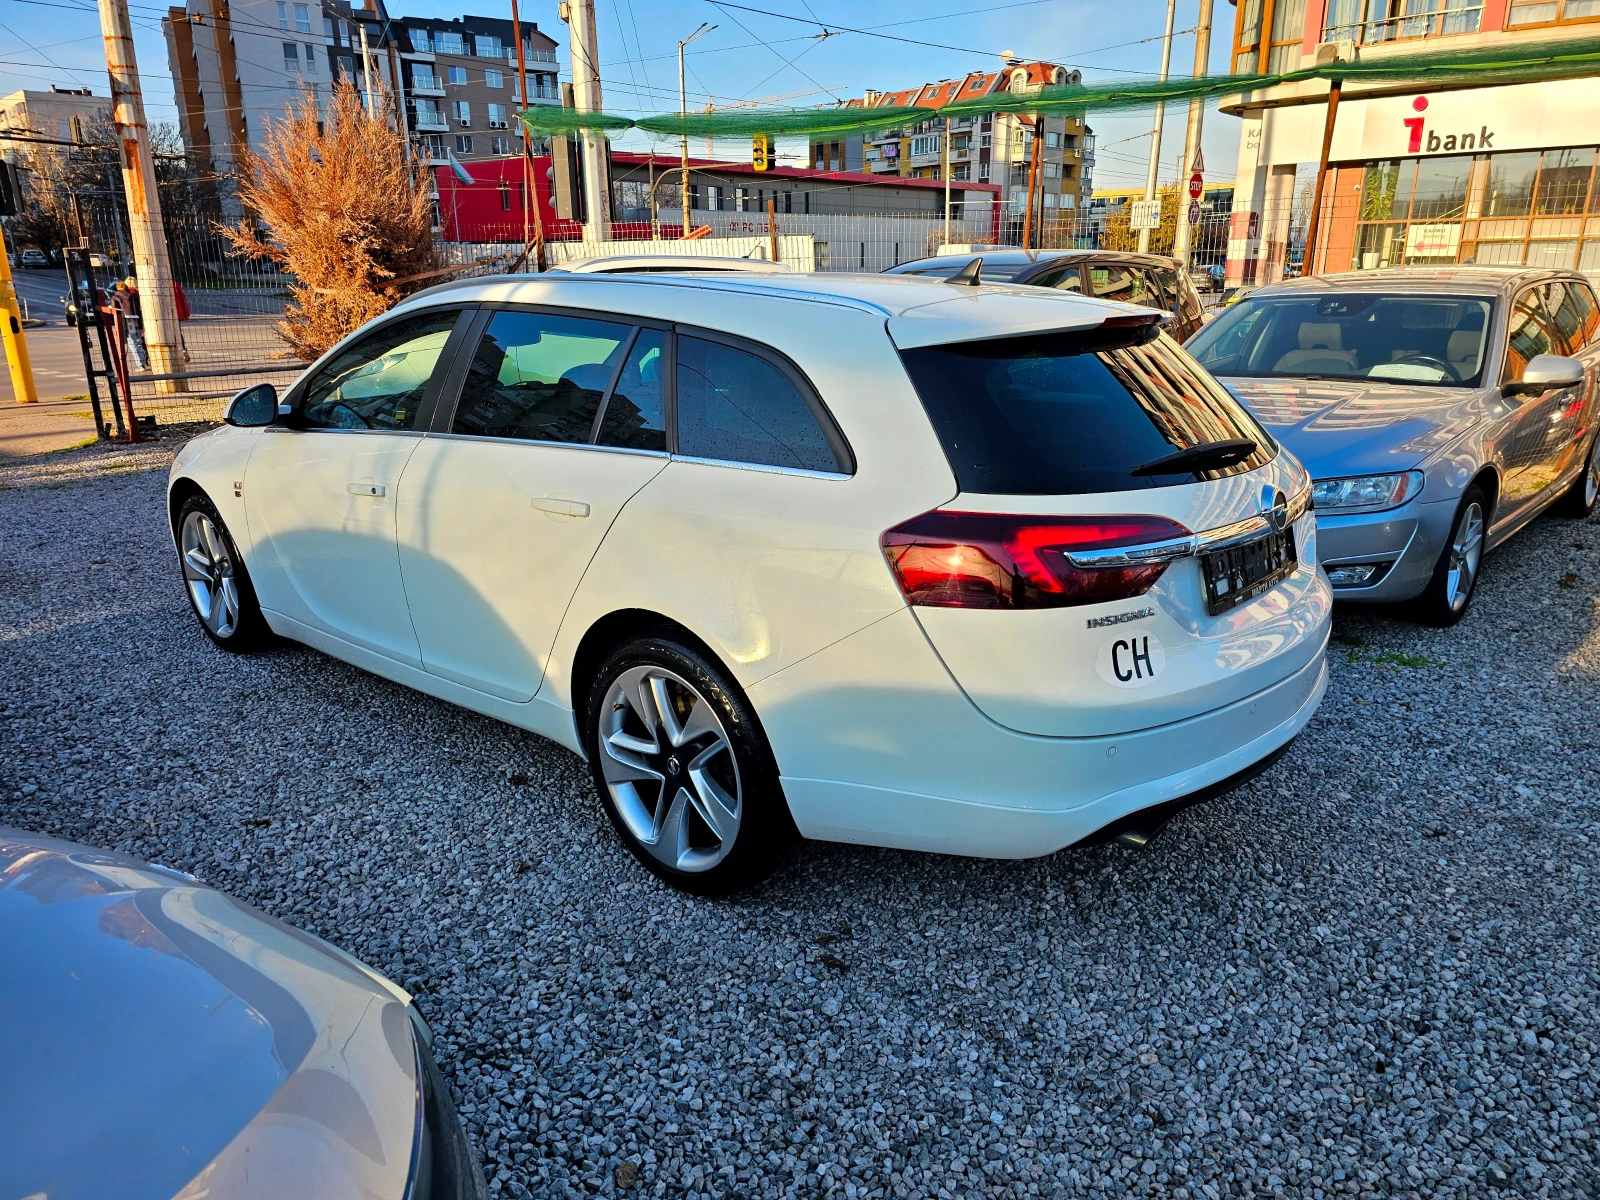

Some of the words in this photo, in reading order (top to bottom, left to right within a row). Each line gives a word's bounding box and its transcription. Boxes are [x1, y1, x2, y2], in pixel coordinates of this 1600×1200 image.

[1190, 181, 1201, 191] STOP
[757, 223, 780, 233] ПБН
[1087, 607, 1155, 629] INSIGNIA
[1112, 636, 1154, 682] CH
